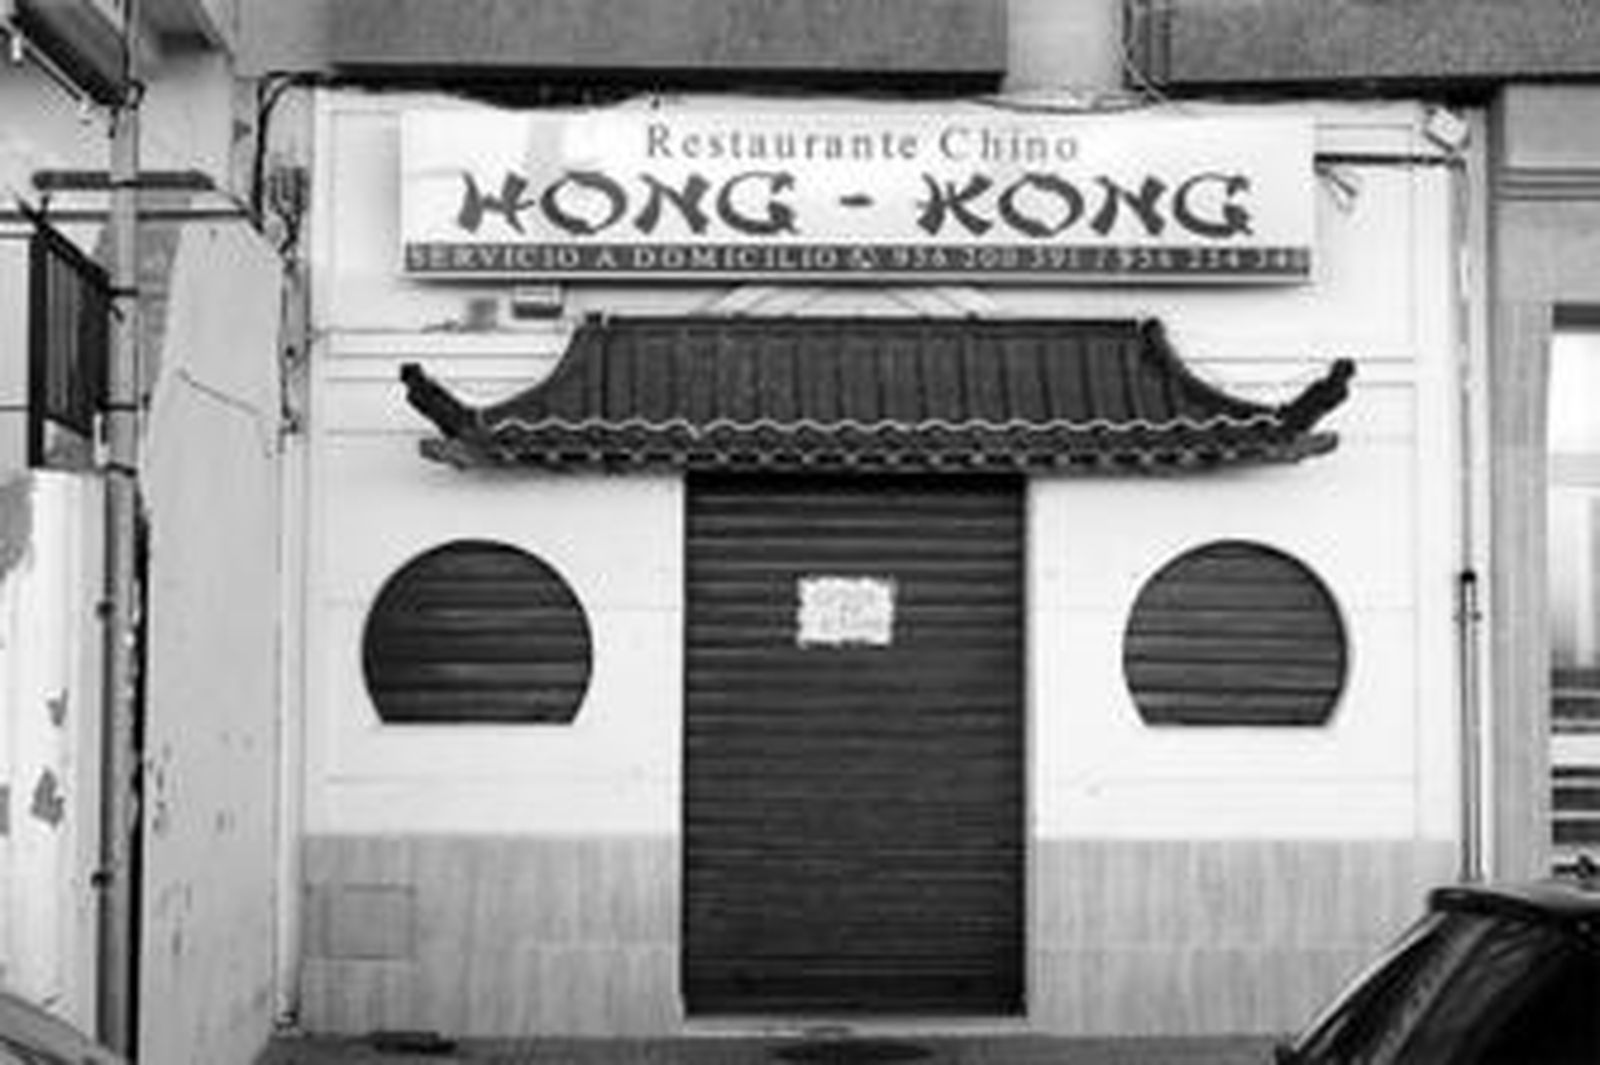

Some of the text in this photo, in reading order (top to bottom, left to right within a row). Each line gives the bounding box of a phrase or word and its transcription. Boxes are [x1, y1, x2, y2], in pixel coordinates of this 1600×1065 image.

[646, 122, 1078, 162] Restaurante Chino
[457, 169, 800, 235] HONG
[916, 171, 1254, 238] KONG
[410, 247, 581, 269] SERVICIO
[595, 248, 619, 269] A
[633, 247, 838, 269] DOMICILIO
